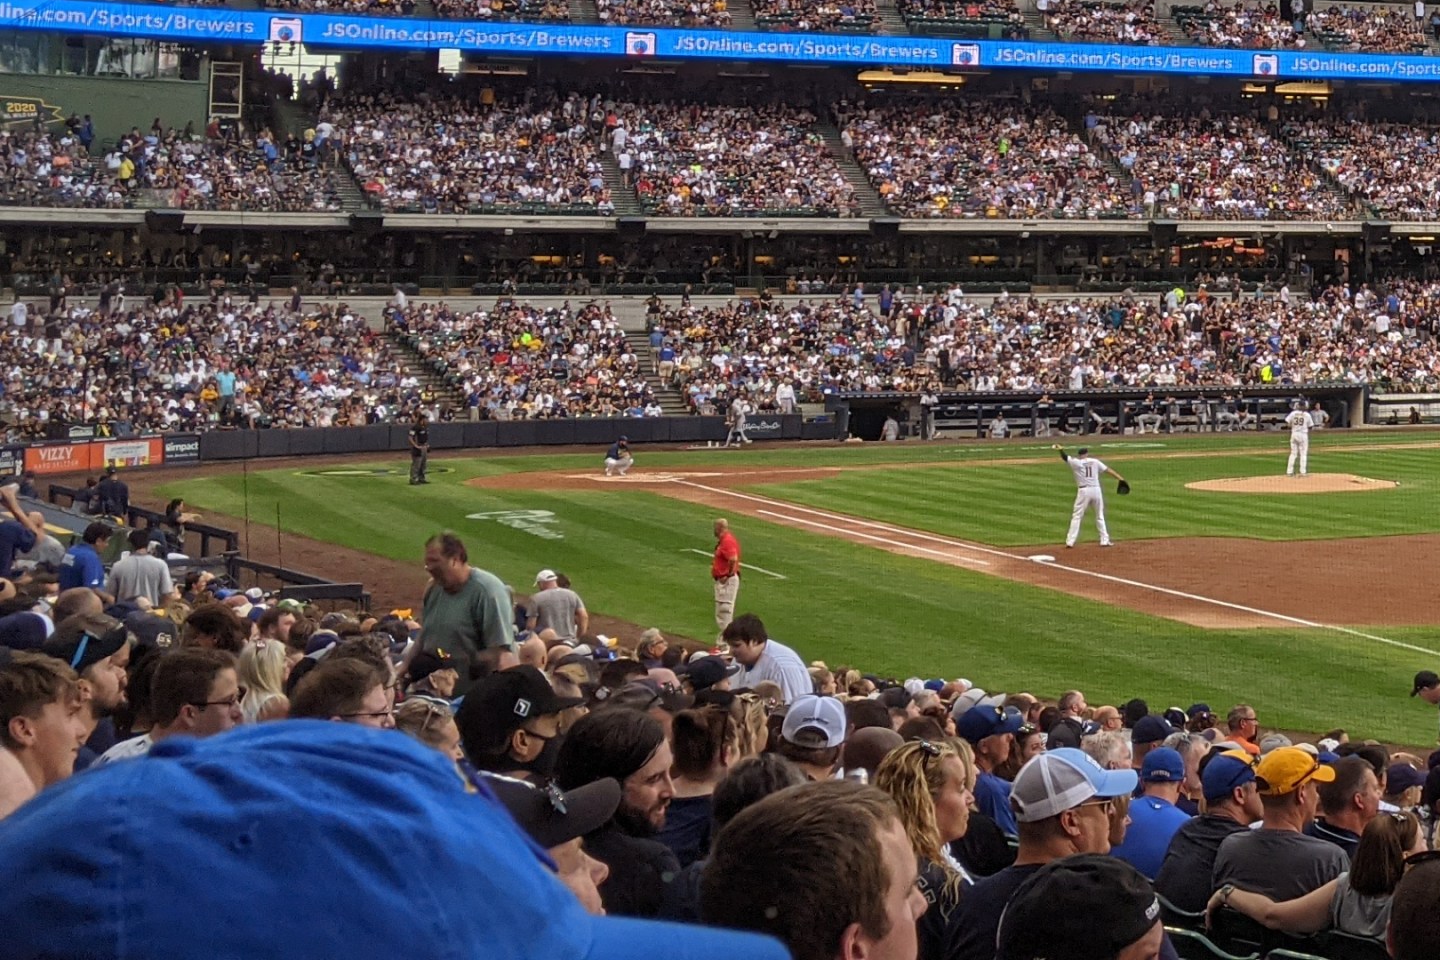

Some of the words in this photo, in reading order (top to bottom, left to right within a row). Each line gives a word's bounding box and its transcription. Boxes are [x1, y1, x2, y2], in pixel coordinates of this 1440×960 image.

[322, 22, 611, 49] JSOnline.com/Sports/Brewers
[673, 36, 938, 59] JSOnline.com/Sports/Brewers
[993, 48, 1233, 70] JSOnline.com/Sports/Brewers
[6, 102, 36, 113] 2020
[1294, 417, 1304, 426] 39
[39, 447, 74, 461] VIZZY
[1085, 466, 1093, 478] 11
